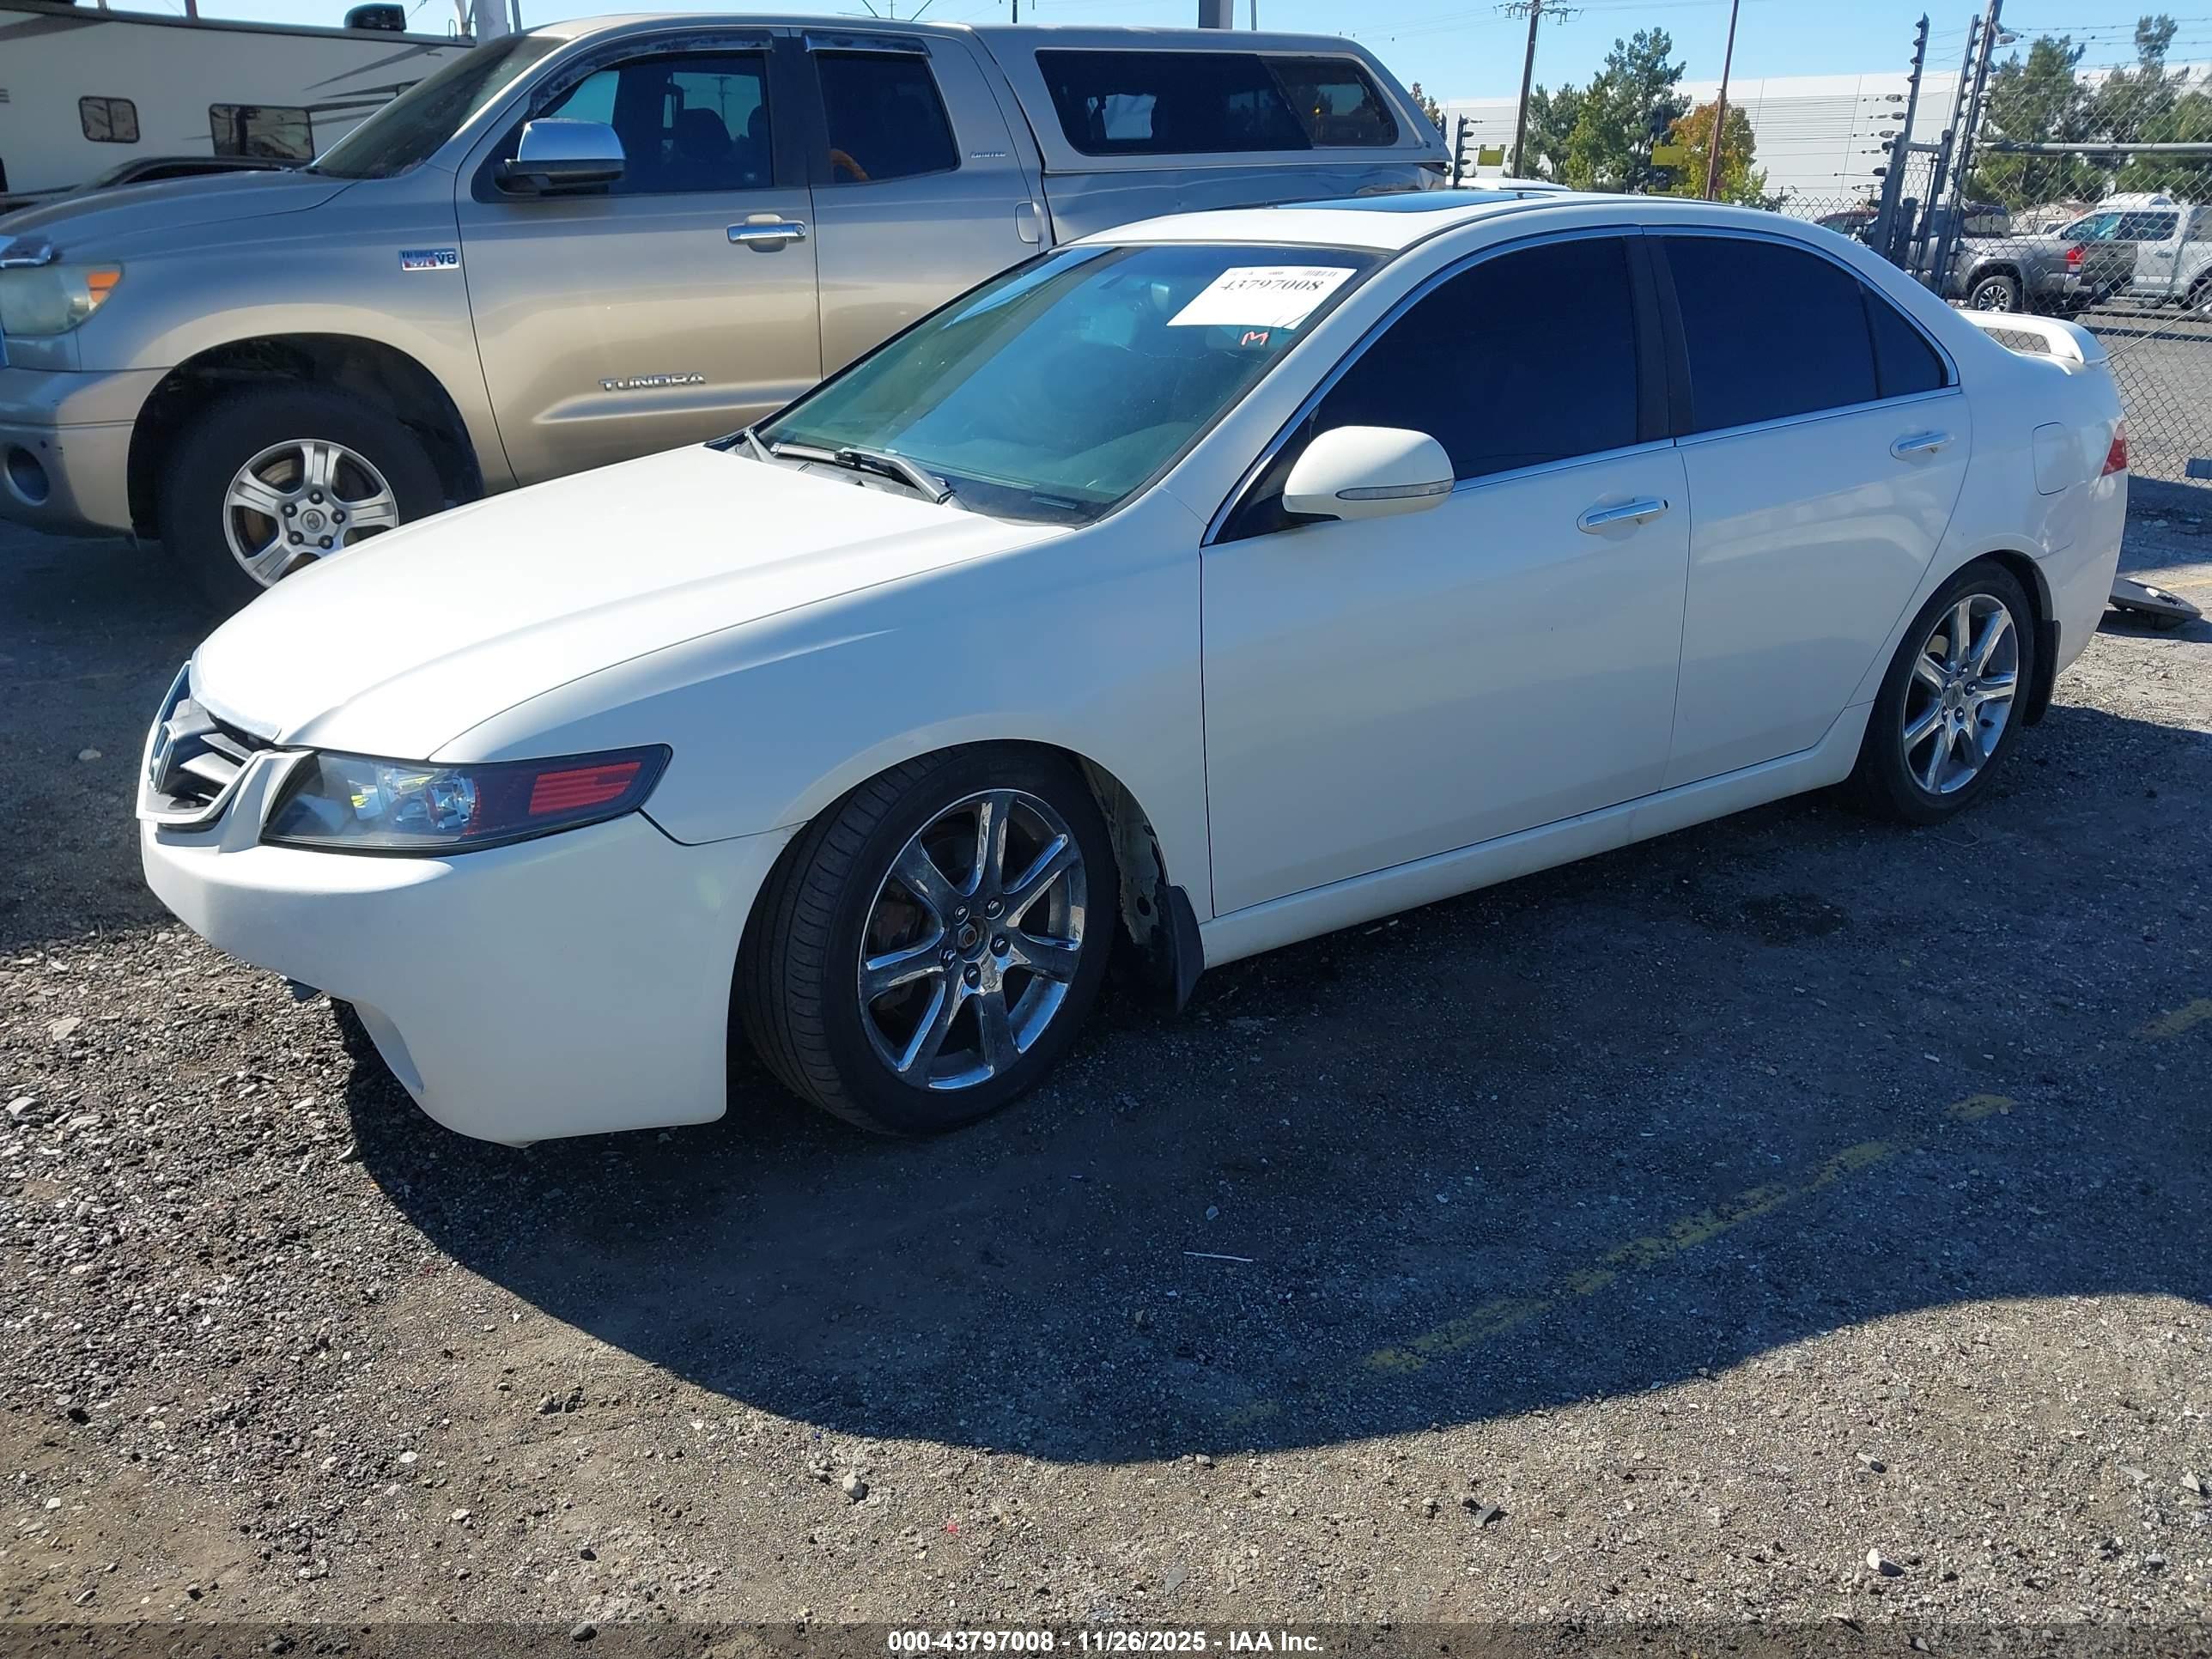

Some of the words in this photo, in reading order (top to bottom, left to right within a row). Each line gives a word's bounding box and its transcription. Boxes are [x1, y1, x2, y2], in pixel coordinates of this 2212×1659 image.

[434, 251, 458, 265] V8
[1220, 278, 1325, 291] 43797008
[599, 372, 706, 392] TUNDRA
